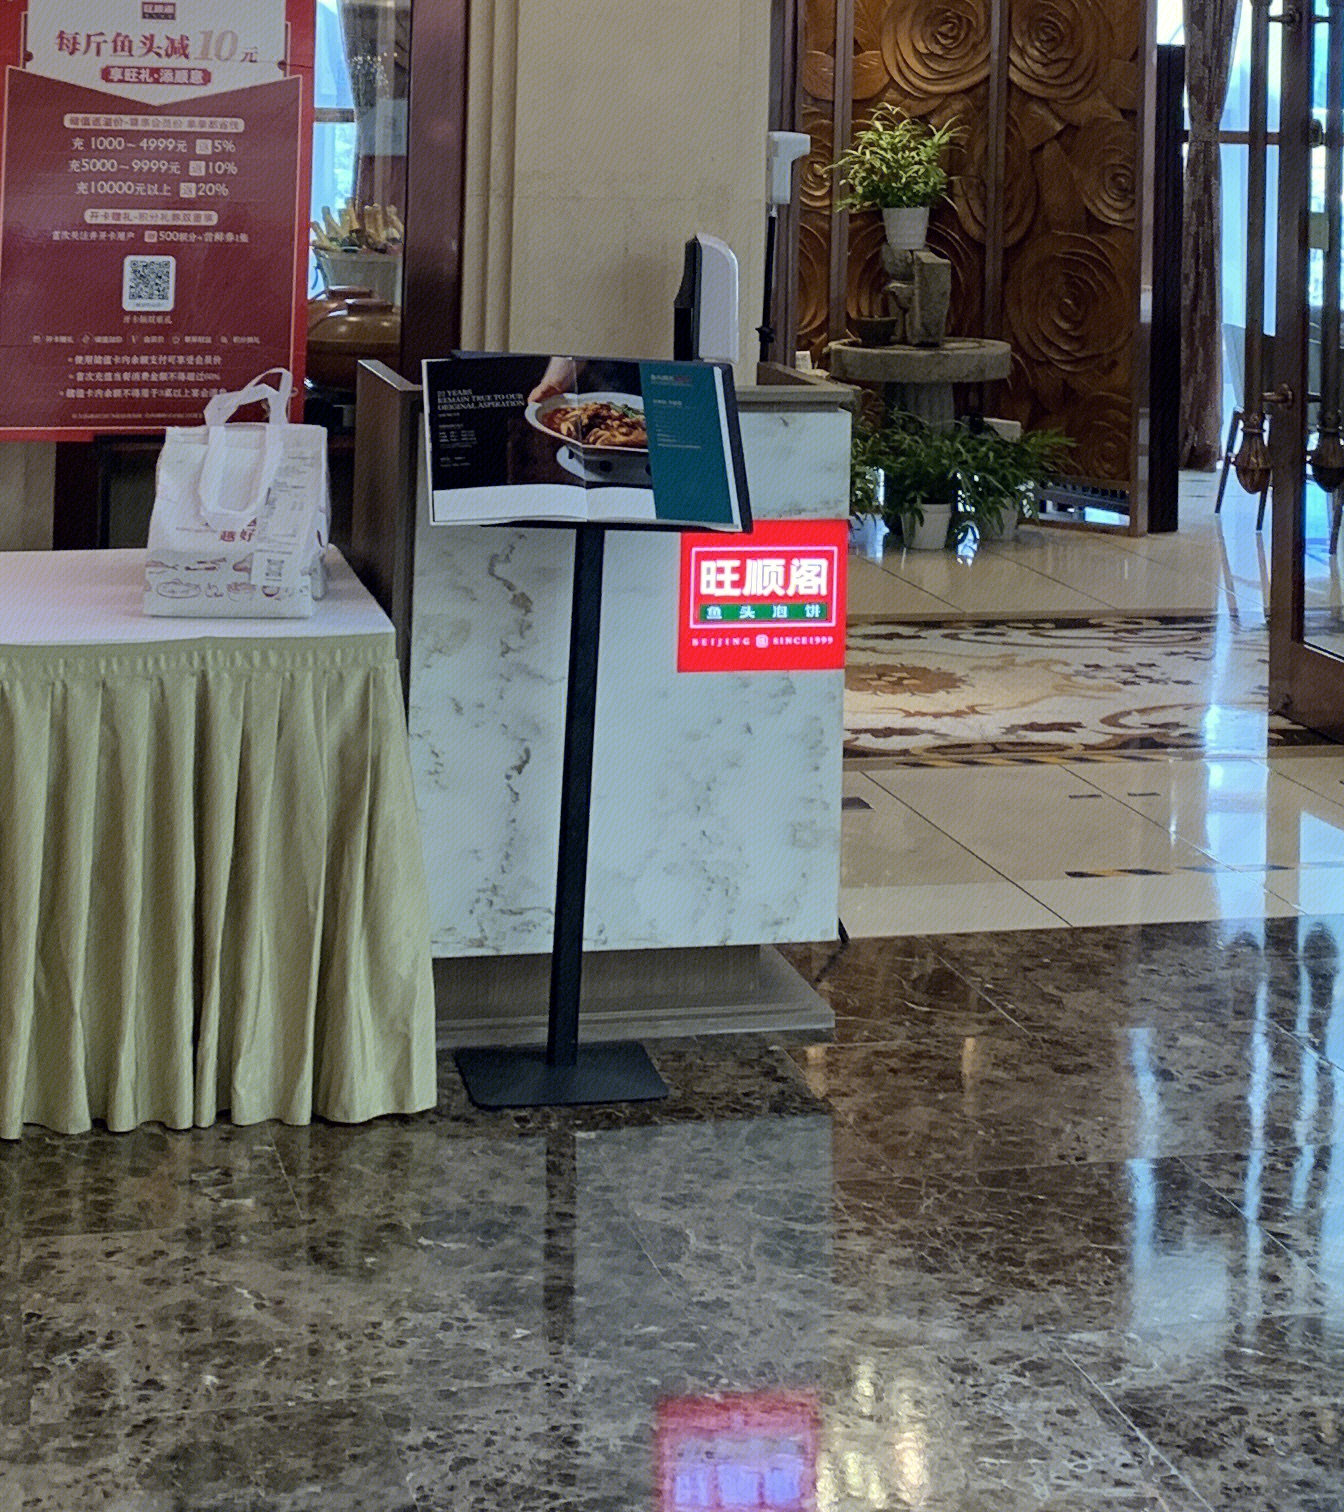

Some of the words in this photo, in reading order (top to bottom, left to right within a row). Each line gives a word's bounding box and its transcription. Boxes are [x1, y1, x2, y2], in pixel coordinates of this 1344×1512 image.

[699, 557, 829, 597] 旺顺阁
[706, 604, 822, 620] 鱼头泡饼
[691, 637, 751, 647] BEIJING
